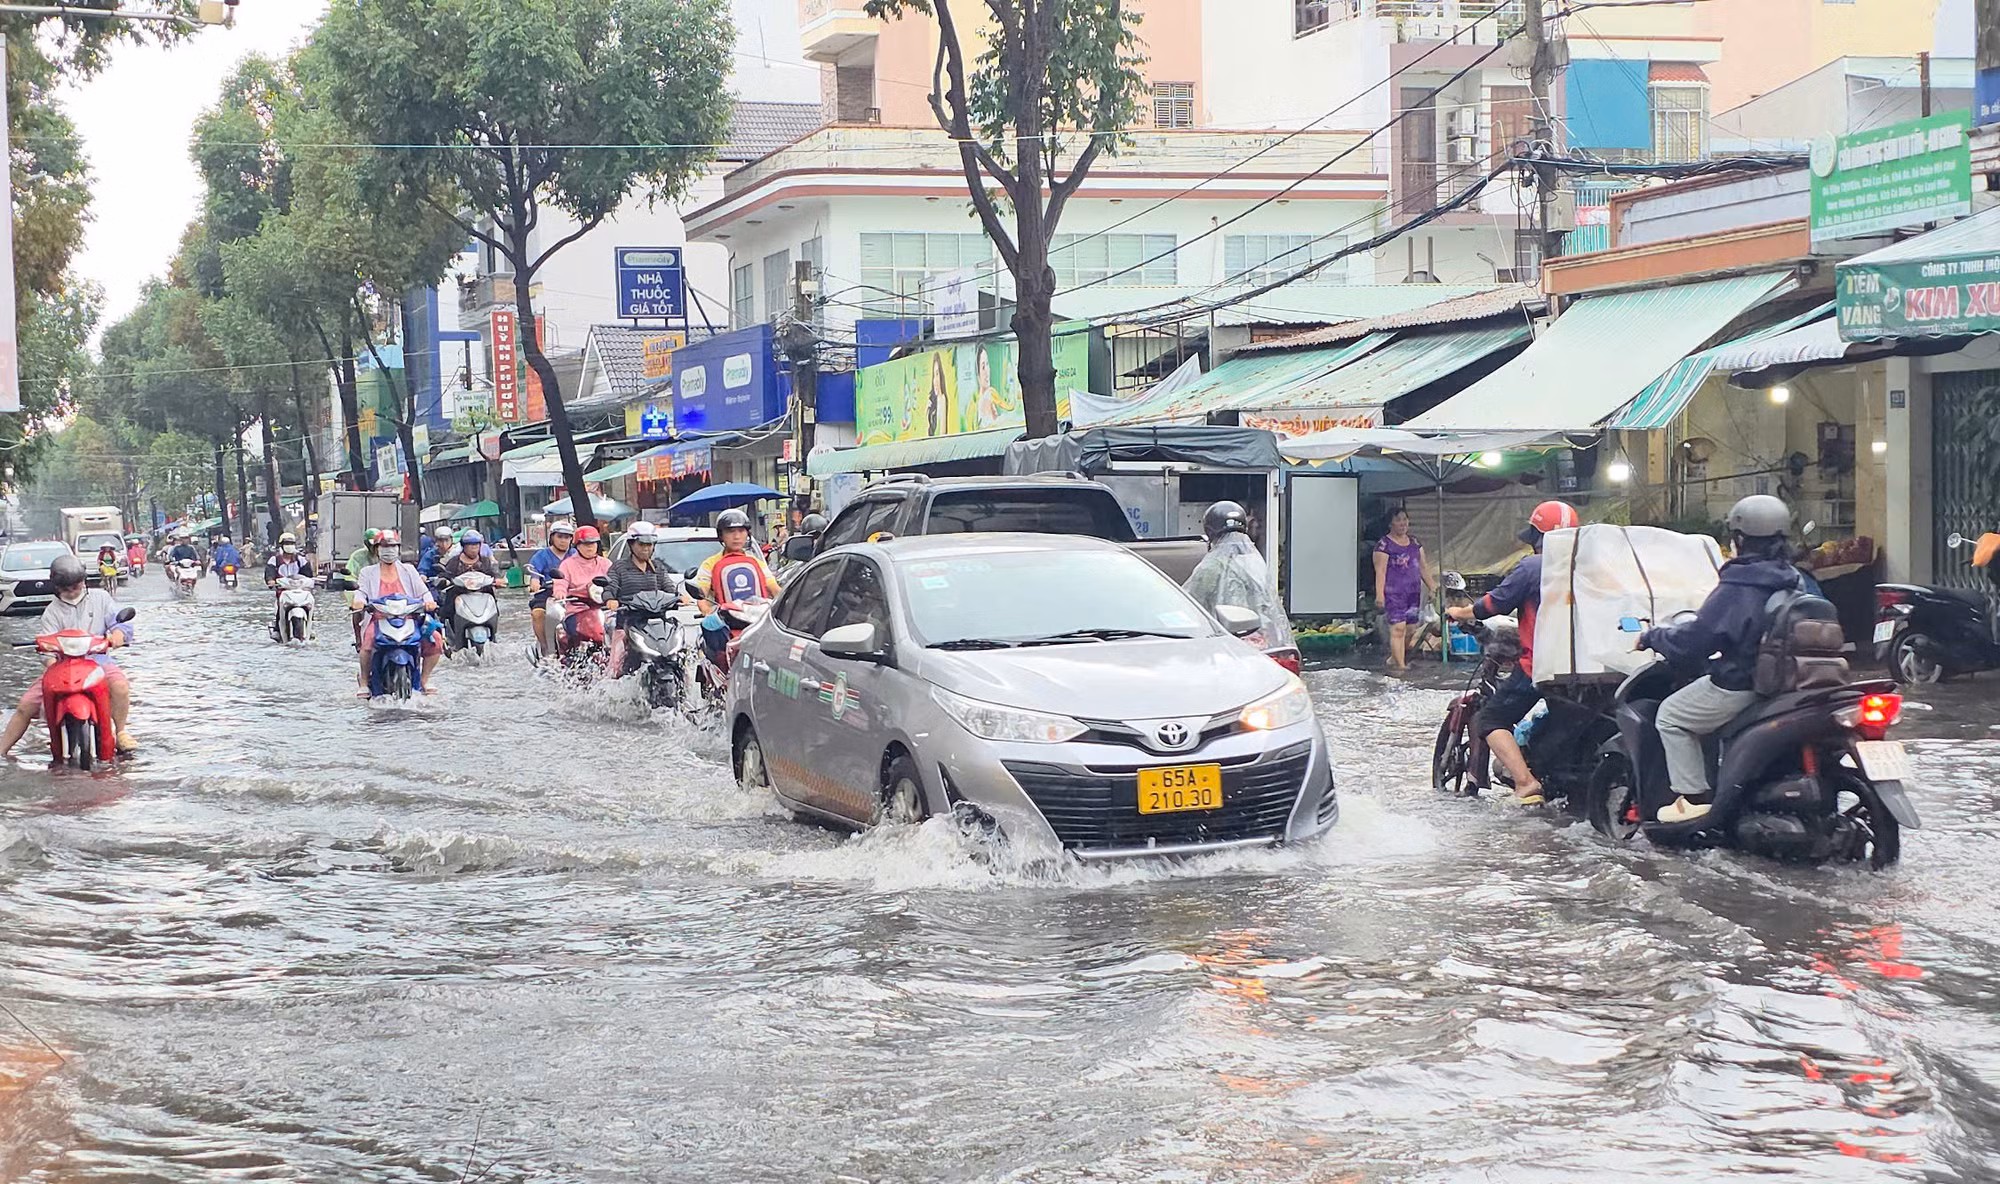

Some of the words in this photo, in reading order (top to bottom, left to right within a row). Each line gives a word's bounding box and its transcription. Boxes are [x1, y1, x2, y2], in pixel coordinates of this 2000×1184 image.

[637, 271, 664, 285] NHÀ
[1922, 261, 1946, 278] CÔNG
[1948, 261, 1958, 275] TY
[1960, 259, 1984, 274] TNHH
[630, 284, 671, 300] THUỐC
[1845, 270, 1881, 298] TIỆM
[630, 301, 650, 314] GIÁ
[652, 299, 674, 314] TỐT
[1842, 301, 1882, 326] VÀNG
[1905, 285, 1959, 321] KIM
[497, 315, 511, 361] HUỲNH
[1163, 768, 1197, 788] 65A
[1150, 788, 1212, 810] 210.30
